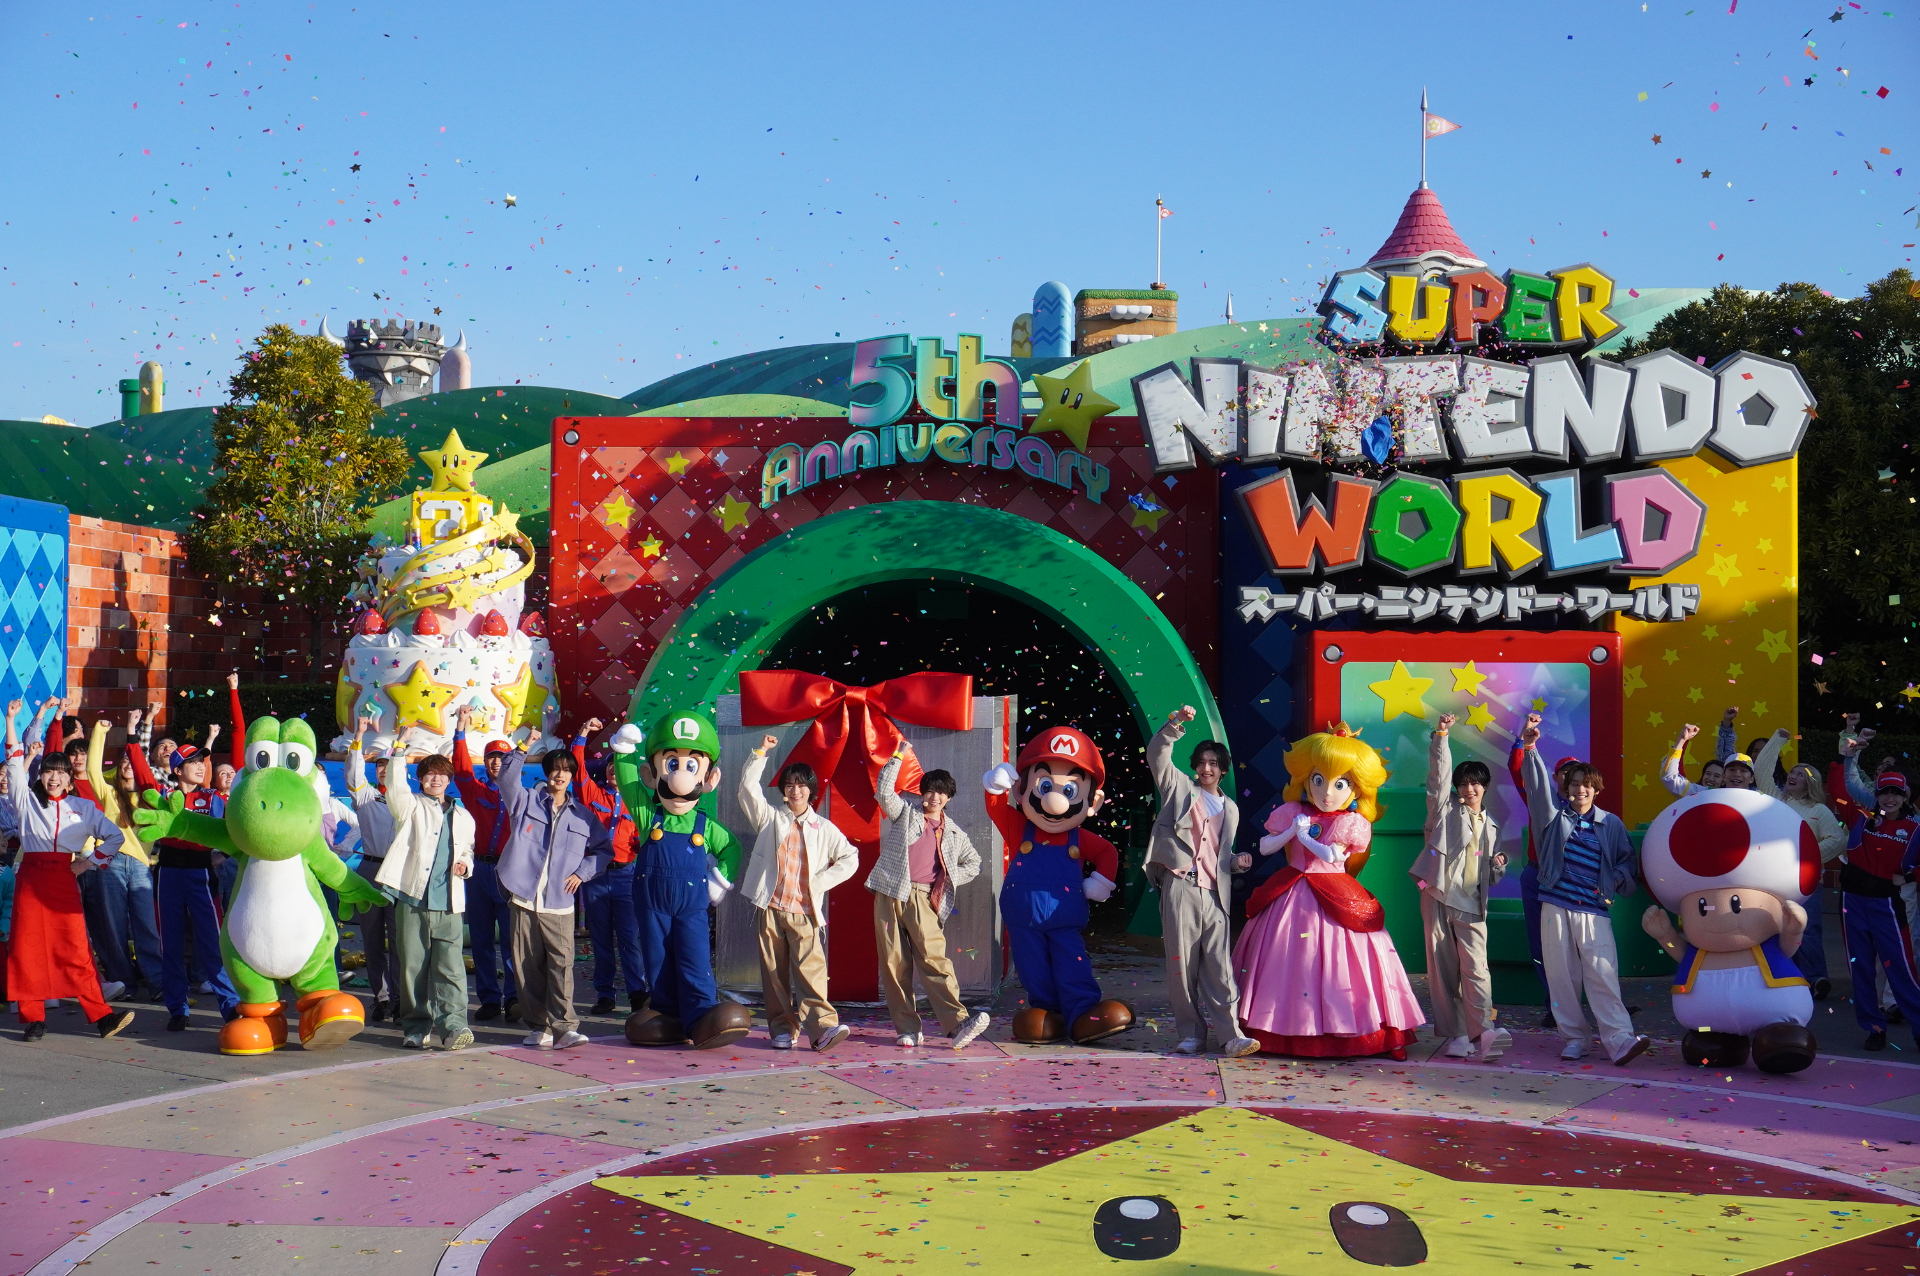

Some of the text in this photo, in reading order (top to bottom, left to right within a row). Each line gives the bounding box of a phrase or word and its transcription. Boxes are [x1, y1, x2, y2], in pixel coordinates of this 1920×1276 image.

[1318, 263, 1623, 350] SUPER
[849, 333, 1023, 430] 5th
[1132, 349, 1816, 472] NINTENDO
[762, 423, 1110, 509] Anniversary
[1236, 467, 1707, 577] WORLD
[681, 721, 693, 737] L
[1053, 737, 1075, 754] M
